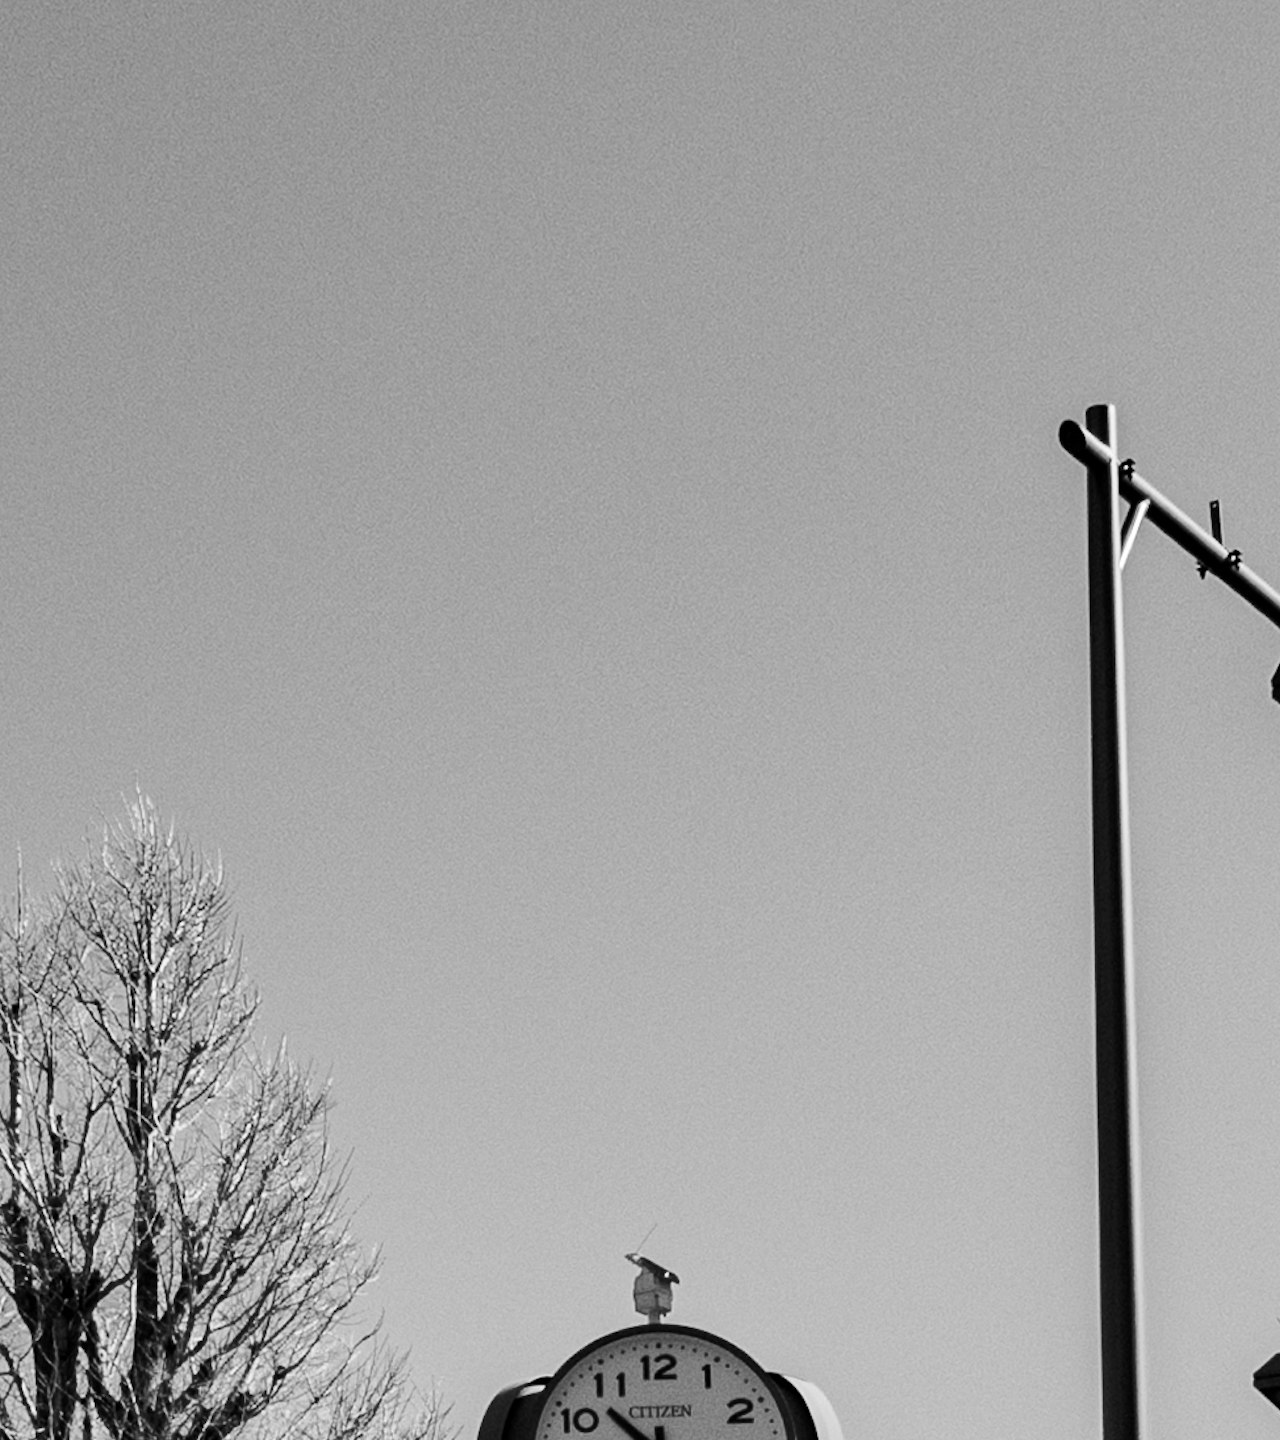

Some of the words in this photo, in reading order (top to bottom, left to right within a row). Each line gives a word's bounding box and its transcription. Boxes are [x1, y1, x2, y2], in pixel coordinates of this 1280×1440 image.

[641, 1354, 677, 1381] 12
[702, 1364, 712, 1389] 1
[594, 1373, 625, 1397] 11
[562, 1408, 599, 1433] 10
[629, 1404, 692, 1419] CITIZEN
[727, 1398, 754, 1424] 2
